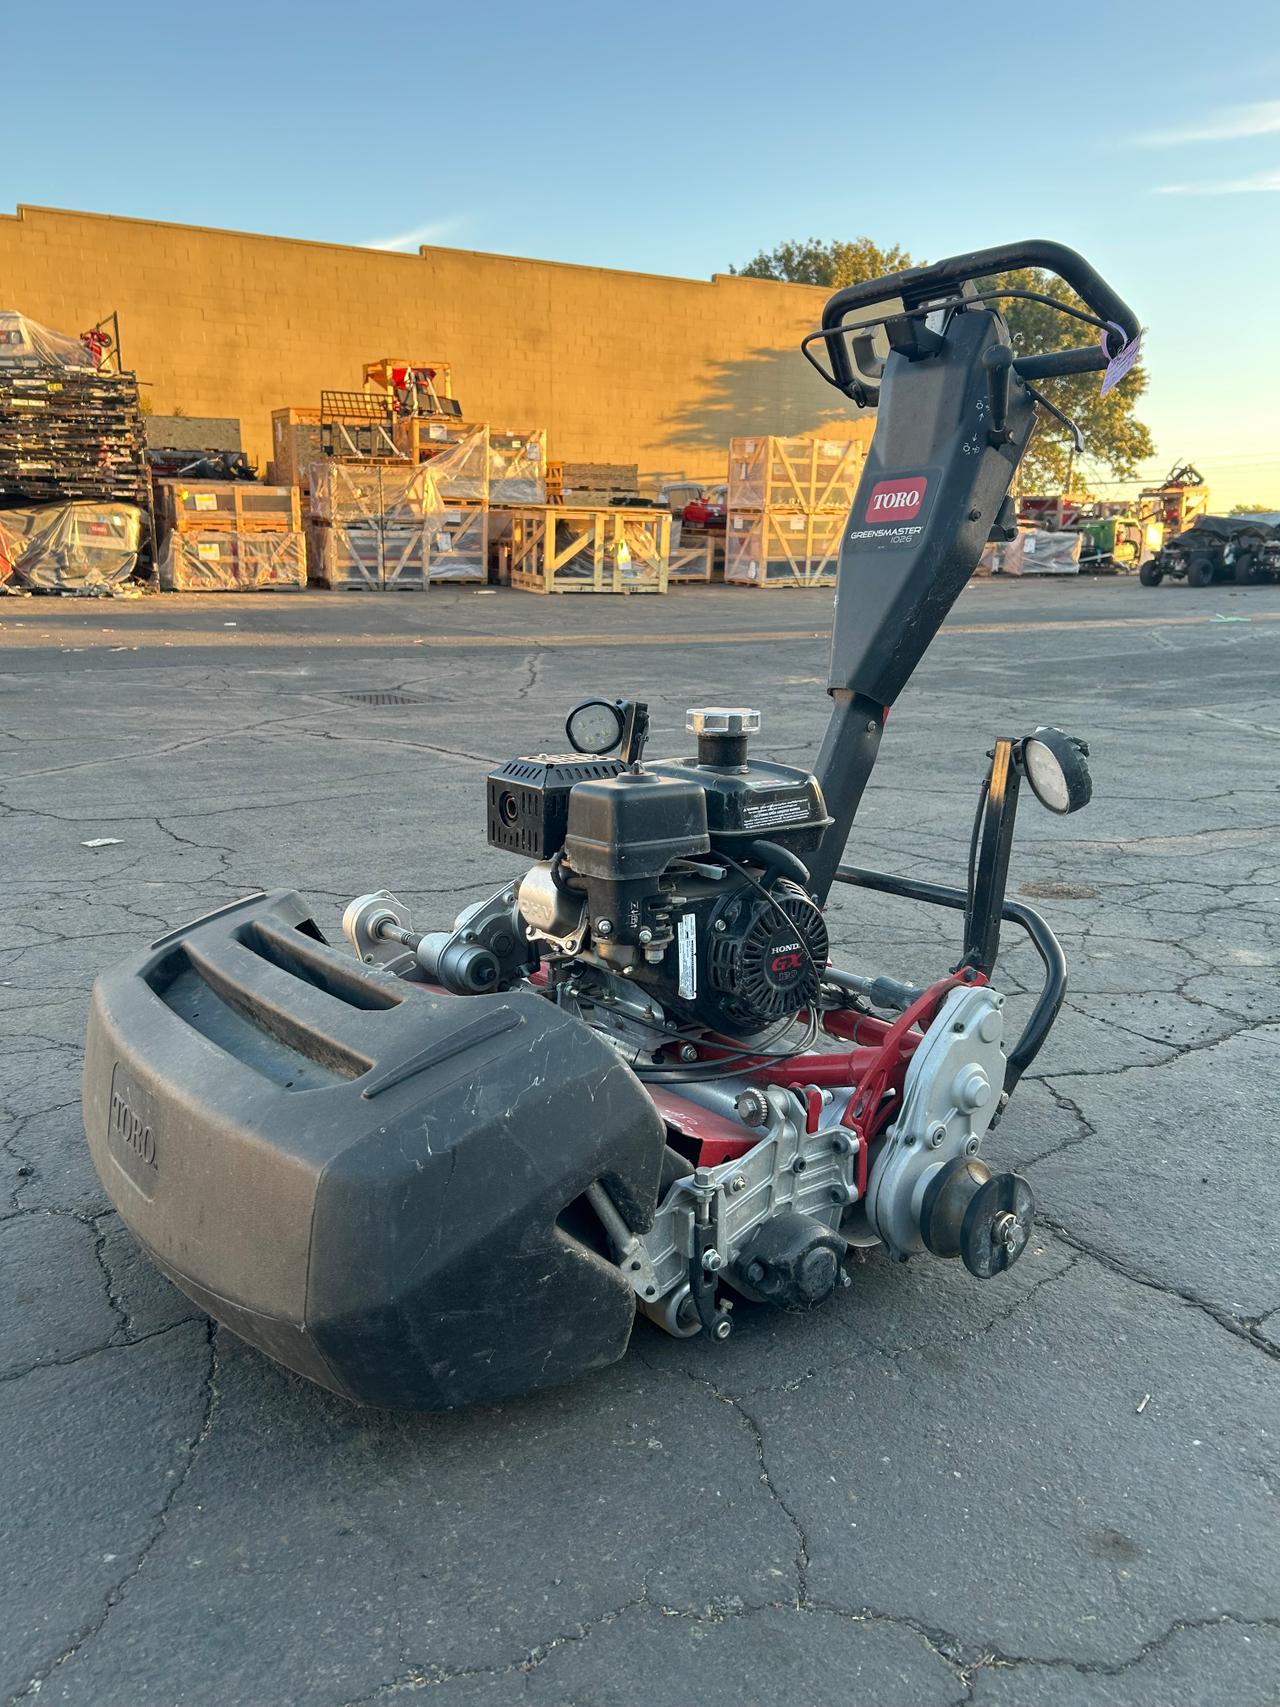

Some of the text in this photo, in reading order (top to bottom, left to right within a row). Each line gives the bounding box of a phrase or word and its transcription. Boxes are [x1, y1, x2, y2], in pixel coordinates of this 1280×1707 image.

[873, 490, 920, 510] TORO
[850, 526, 923, 539] GREENSMASTER
[890, 535, 912, 544] 1026
[771, 943, 801, 954] HOND
[771, 953, 804, 972] GX
[112, 1092, 156, 1165] TORO
